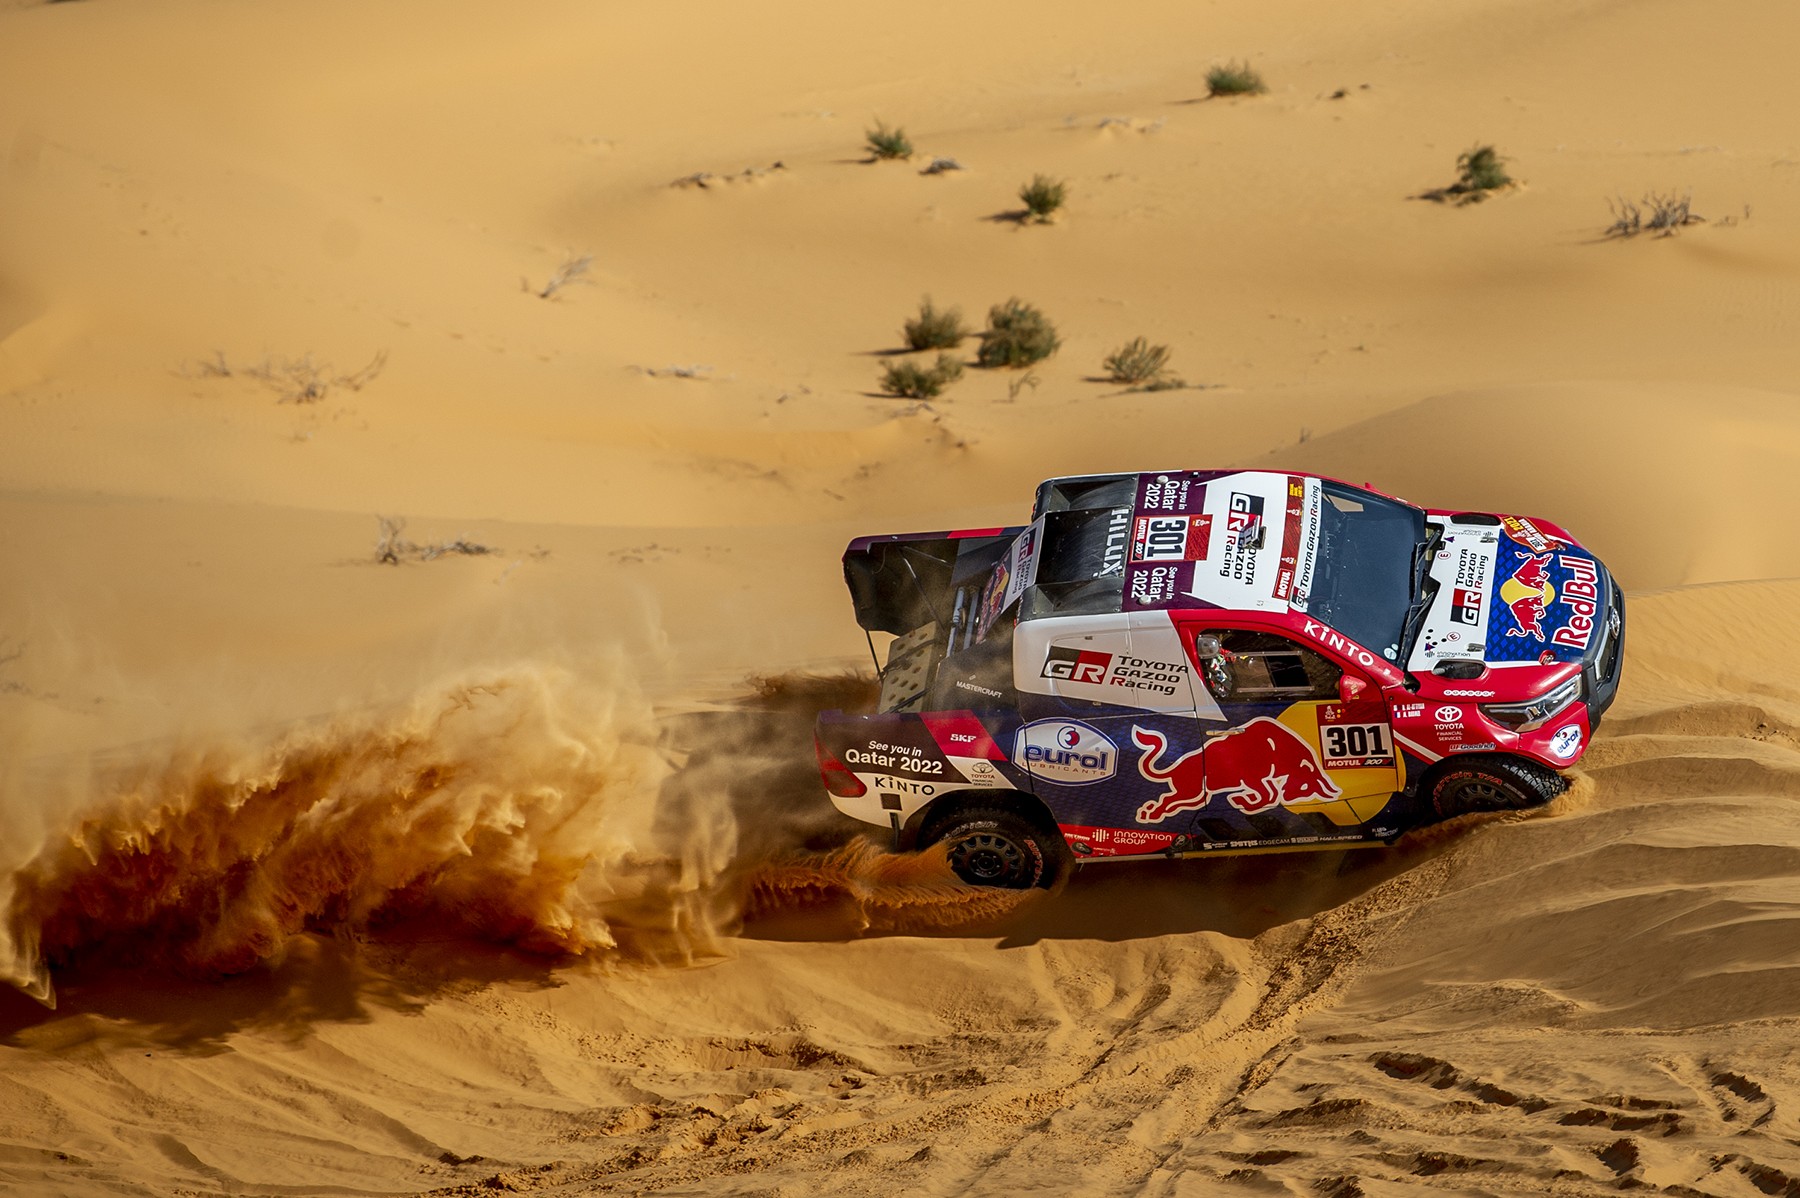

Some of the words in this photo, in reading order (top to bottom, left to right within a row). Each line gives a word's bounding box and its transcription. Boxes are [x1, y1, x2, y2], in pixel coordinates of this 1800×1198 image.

[1144, 483, 1161, 509] 2022
[1162, 480, 1180, 510] Qatar
[1310, 485, 1320, 517] Racing
[1137, 518, 1148, 540] MOTUL
[1306, 518, 1318, 553] GAZOO
[1504, 516, 1523, 531] 2021
[1099, 509, 1129, 578] HILUX
[1147, 520, 1187, 557] 301
[1219, 535, 1236, 578] Racing
[1234, 541, 1246, 580] AZOO
[1245, 546, 1257, 585] OYOTA
[1455, 548, 1468, 586] TOYOTA
[1150, 567, 1168, 600] Qatar
[1299, 553, 1313, 588] TOYOTA
[1465, 553, 1477, 588] GAZOO
[1474, 555, 1489, 589] Racing
[1131, 570, 1149, 598] 2022
[1277, 571, 1291, 597] MOTUL
[1295, 589, 1306, 608] GR
[1462, 591, 1481, 625] GR
[1043, 659, 1106, 684] GR
[1113, 667, 1181, 684] GAZOO
[1117, 655, 1189, 674] TOYOTA
[955, 680, 1002, 698] MASTERCRAFT
[1109, 677, 1176, 696] Racing
[868, 740, 888, 751] See
[890, 744, 910, 755] you
[911, 747, 922, 757] in
[950, 733, 977, 743] SKF
[1326, 725, 1388, 757] 301
[1557, 731, 1582, 753] eurol
[845, 748, 896, 767] Qatar
[900, 756, 943, 775] 2022
[1021, 762, 1106, 776] LUBRICANTS
[1023, 744, 1108, 771] eurol
[1327, 759, 1360, 767] MOTUL
[1113, 830, 1172, 842] INNOVATION
[1113, 837, 1146, 846] GROUP
[1258, 837, 1290, 846] EDGECAM
